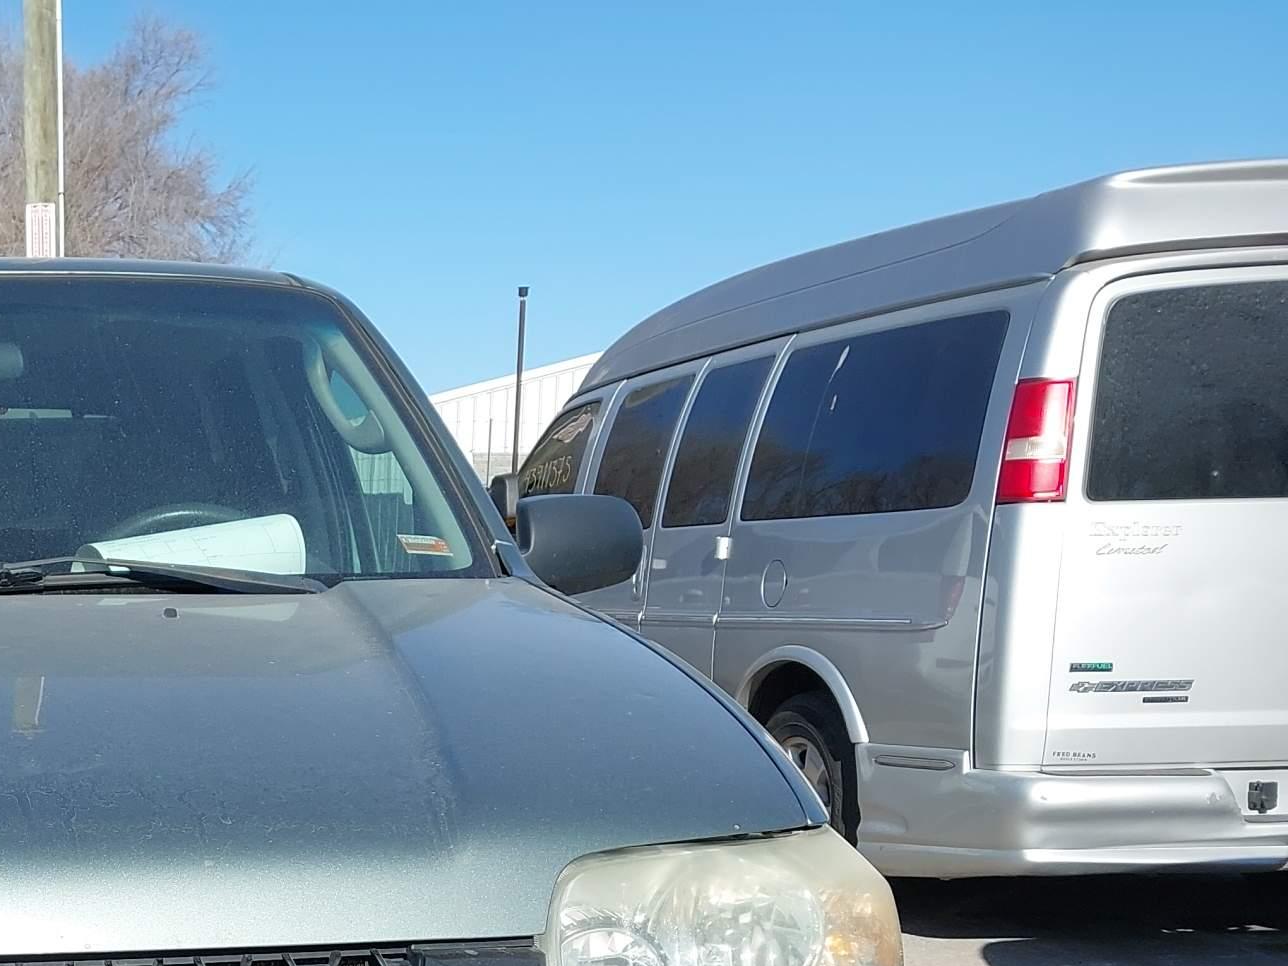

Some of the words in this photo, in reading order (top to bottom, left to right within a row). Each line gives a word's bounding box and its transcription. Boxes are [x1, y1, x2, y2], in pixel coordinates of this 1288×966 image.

[1089, 521, 1184, 541] Explorer
[1095, 679, 1195, 693] EXPRESS
[1072, 751, 1097, 759] BEANS
